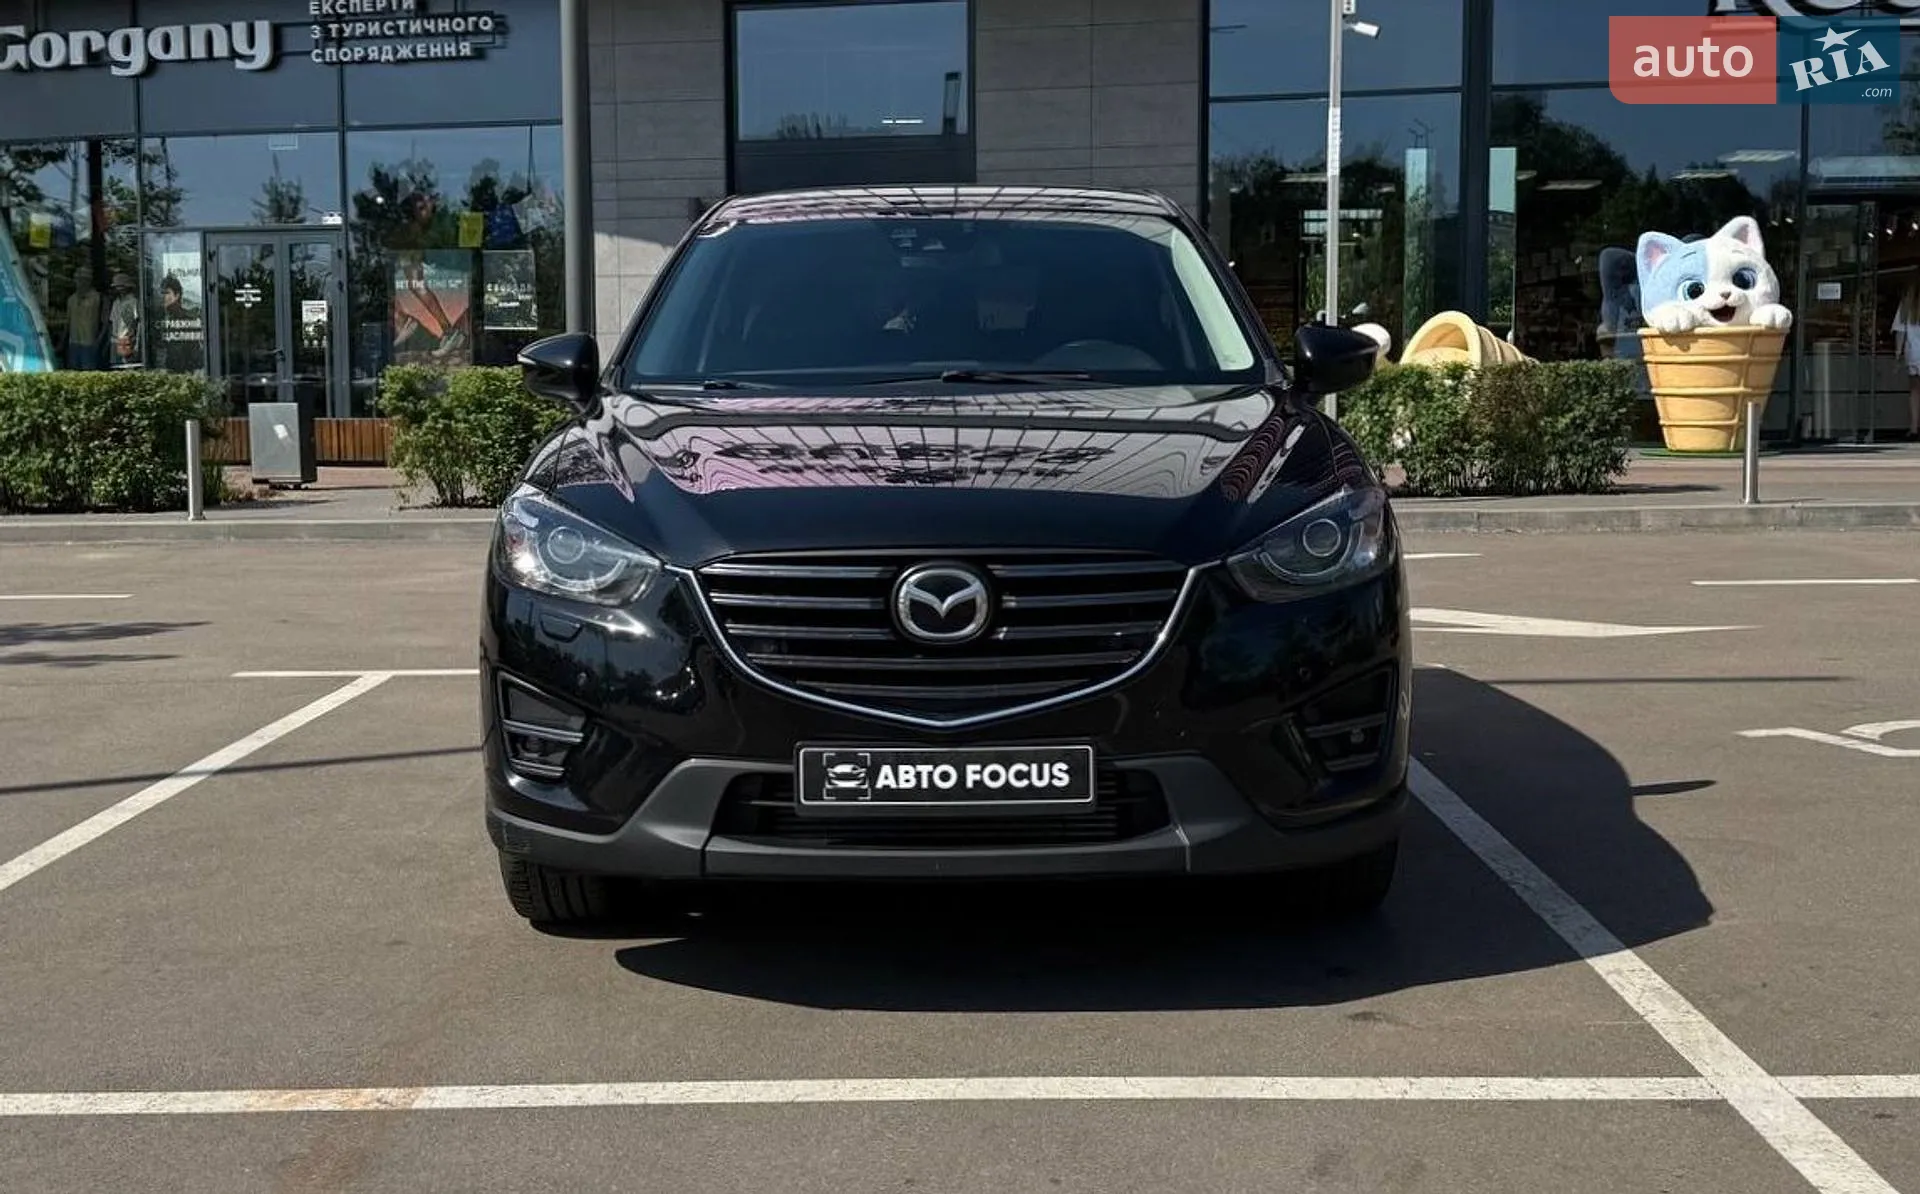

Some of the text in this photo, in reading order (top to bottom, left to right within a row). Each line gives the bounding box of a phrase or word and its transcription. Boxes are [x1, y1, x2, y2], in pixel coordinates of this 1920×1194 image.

[309, 0, 415, 14] ЕКСПЕРТИ
[328, 16, 493, 38] ТУРИСТИЧНОГО
[0, 20, 274, 76] Gorgany
[311, 42, 472, 64] СПОРЯДЖЕННЯ
[875, 762, 1071, 790] АВТО FOCUS
